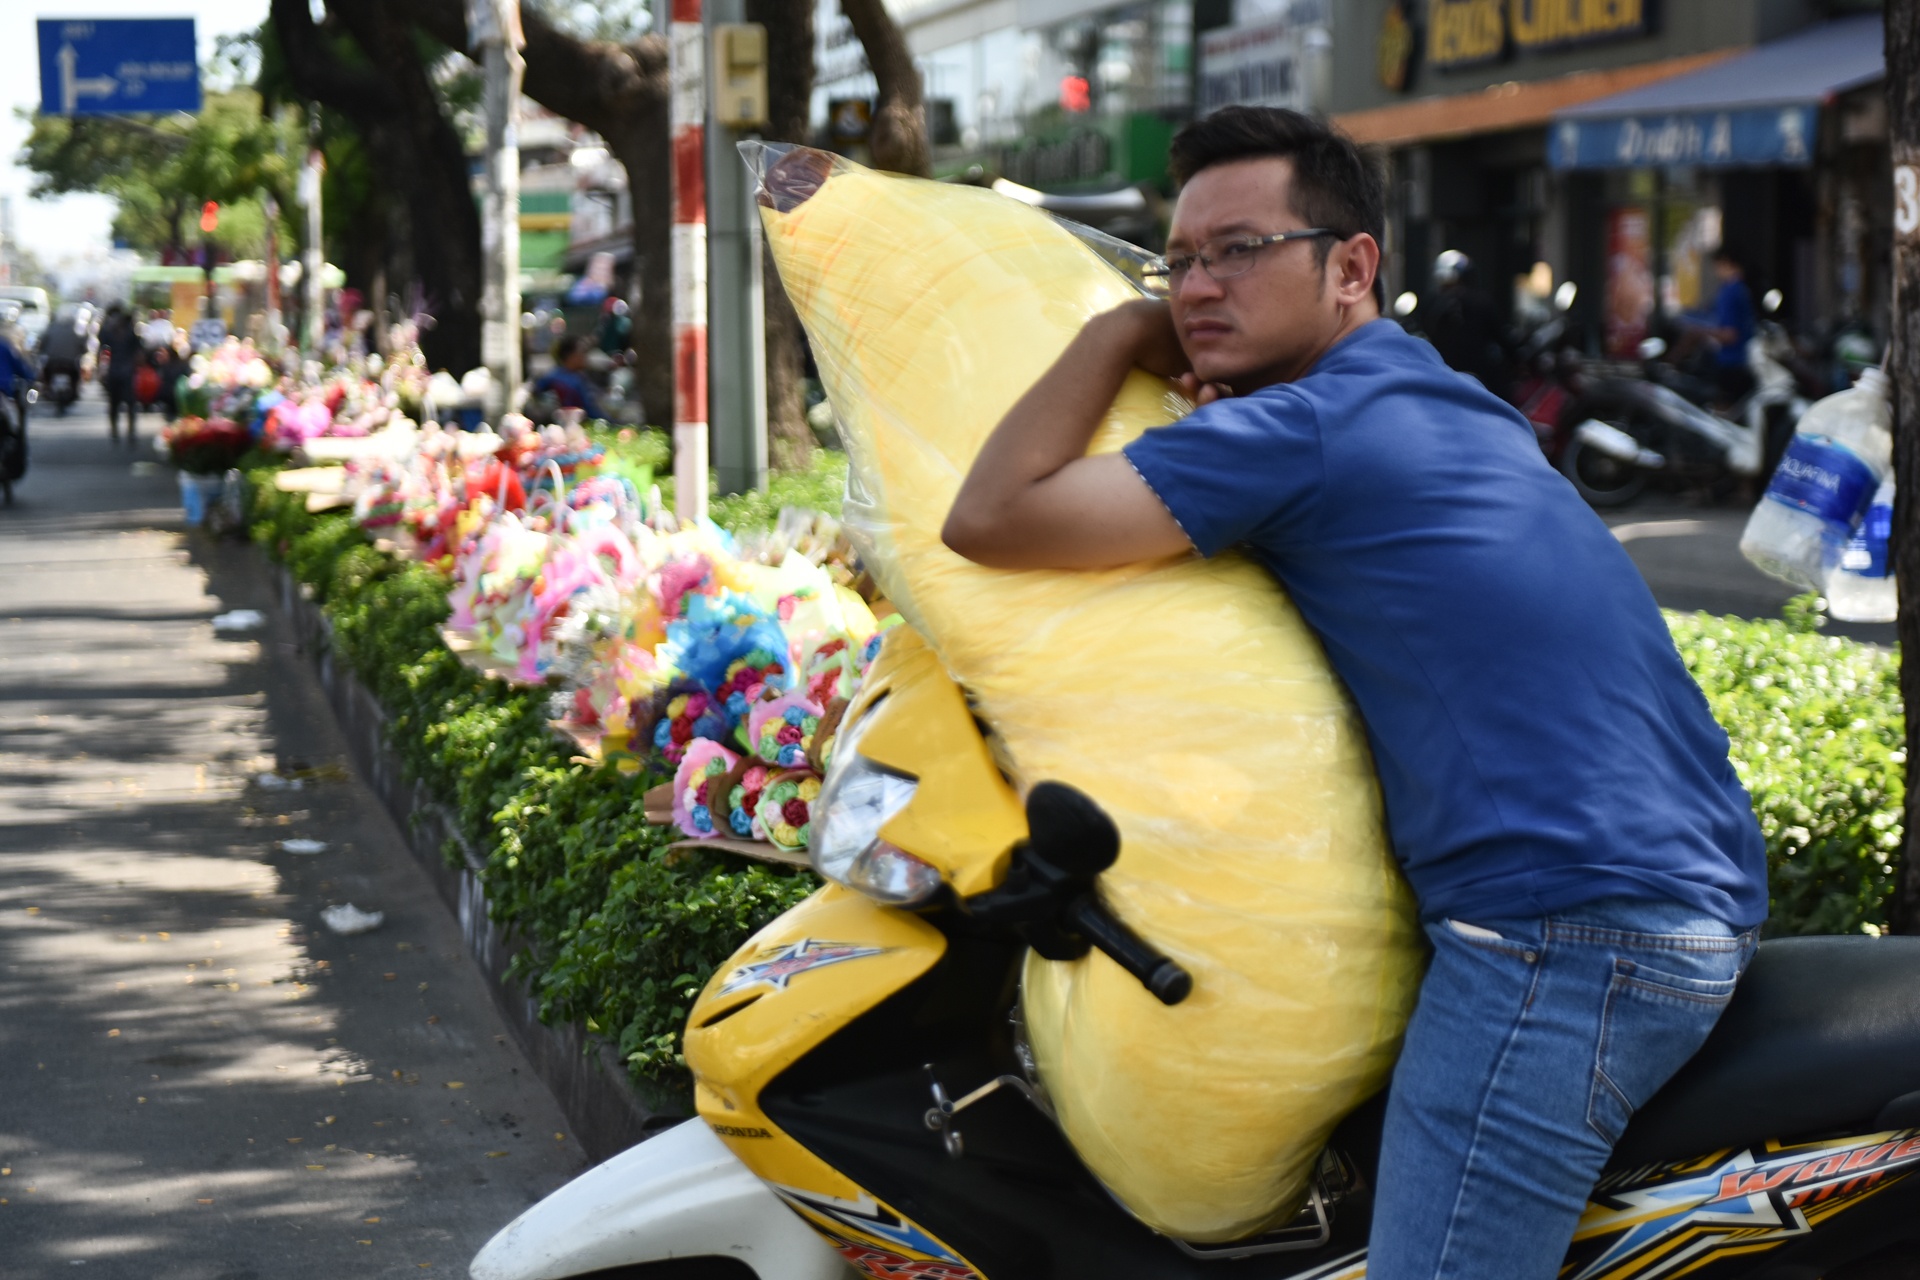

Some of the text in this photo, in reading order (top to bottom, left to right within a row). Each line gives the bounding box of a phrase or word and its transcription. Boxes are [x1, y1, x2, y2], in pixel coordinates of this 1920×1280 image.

[1893, 164, 1920, 234] 3
[1779, 456, 1841, 495] AQUAFINA
[713, 1123, 774, 1139] HONDA
